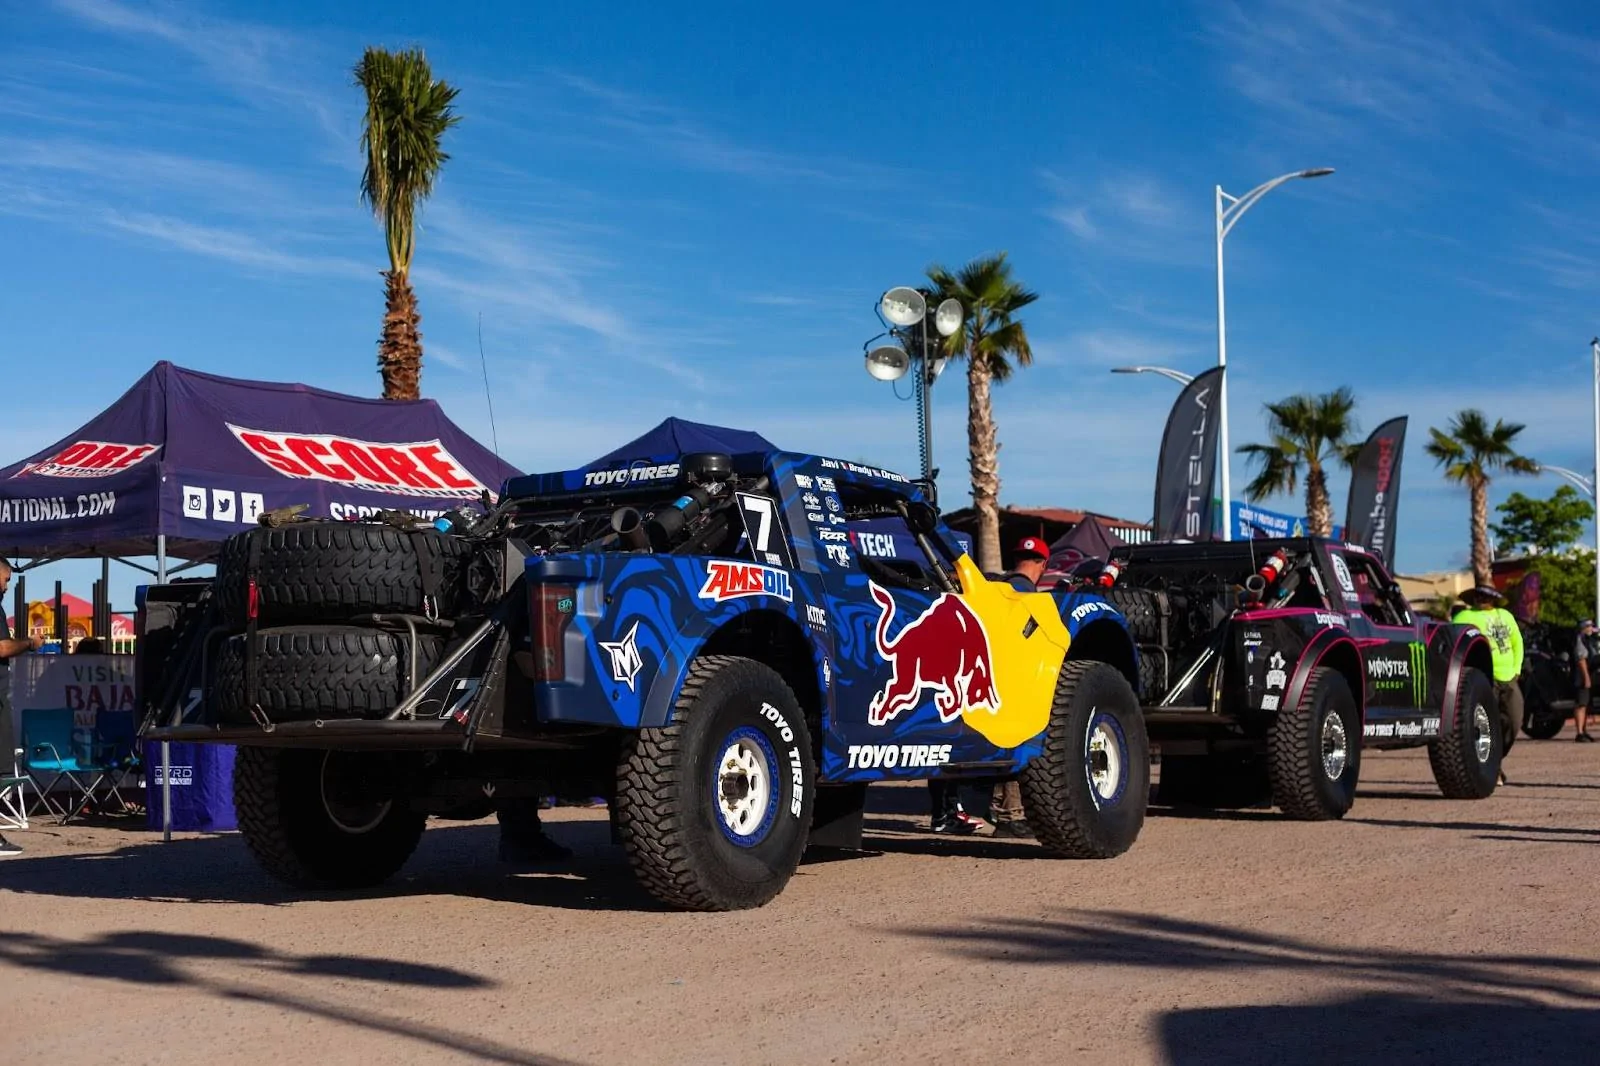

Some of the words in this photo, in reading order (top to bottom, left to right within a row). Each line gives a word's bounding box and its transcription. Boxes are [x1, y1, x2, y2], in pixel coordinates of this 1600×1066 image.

[239, 431, 477, 489] SCORE
[848, 463, 872, 477] Brady
[1186, 388, 1209, 537] STELLA
[585, 469, 628, 486] TOYO
[630, 464, 680, 481] TIRES
[743, 496, 772, 552] 7
[819, 531, 848, 542] RZR
[857, 532, 897, 558] TECH
[702, 562, 793, 601] AMSOIL
[1071, 602, 1099, 622] TOYO
[71, 665, 125, 682] VISIT
[1367, 656, 1410, 678] MONSTER
[1375, 681, 1404, 689] ENERGY
[65, 684, 135, 712] BAJA
[760, 702, 794, 743] TOYO
[788, 746, 804, 819] TIRES
[847, 744, 900, 769] TOYO
[900, 744, 953, 767] TIRES
